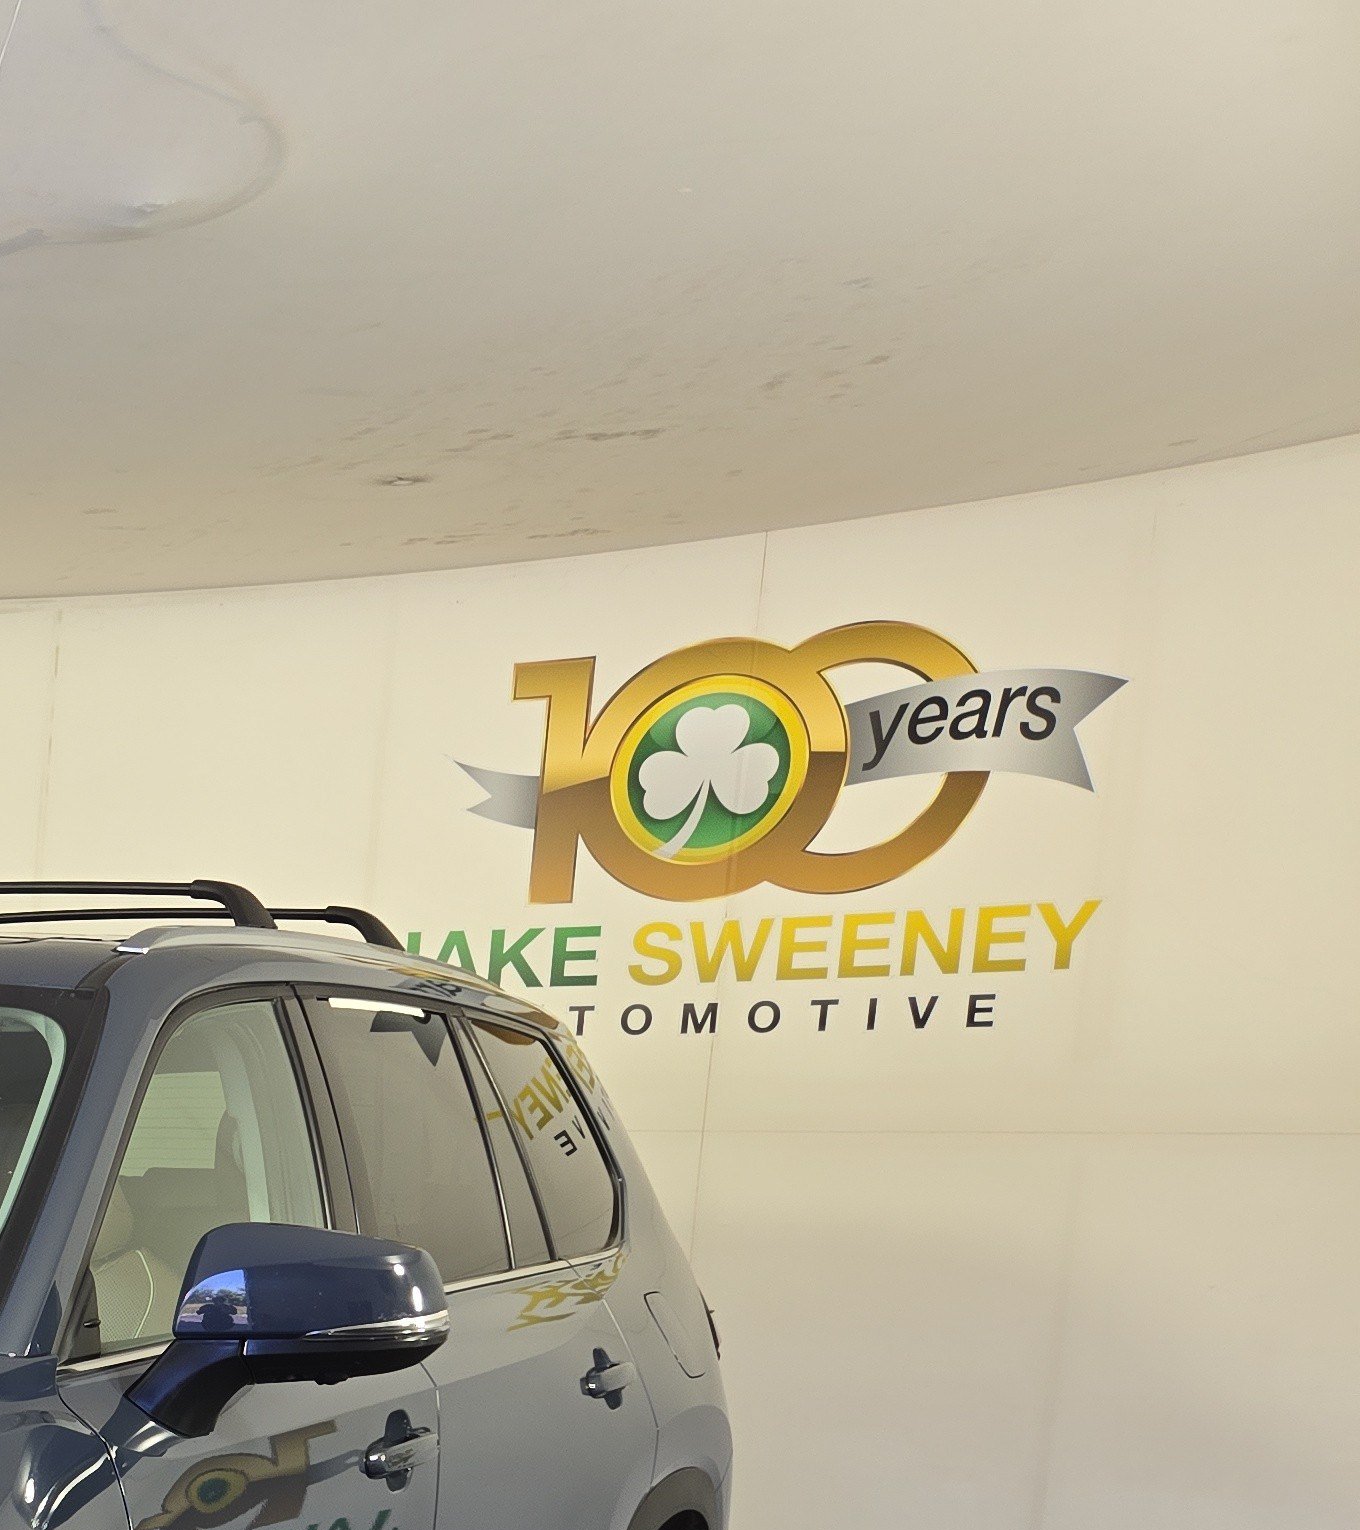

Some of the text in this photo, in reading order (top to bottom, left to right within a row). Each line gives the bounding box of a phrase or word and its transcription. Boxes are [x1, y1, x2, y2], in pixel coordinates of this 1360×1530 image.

[511, 619, 991, 906] 100
[862, 684, 1062, 771] years
[627, 899, 1102, 987] SWEENEY
